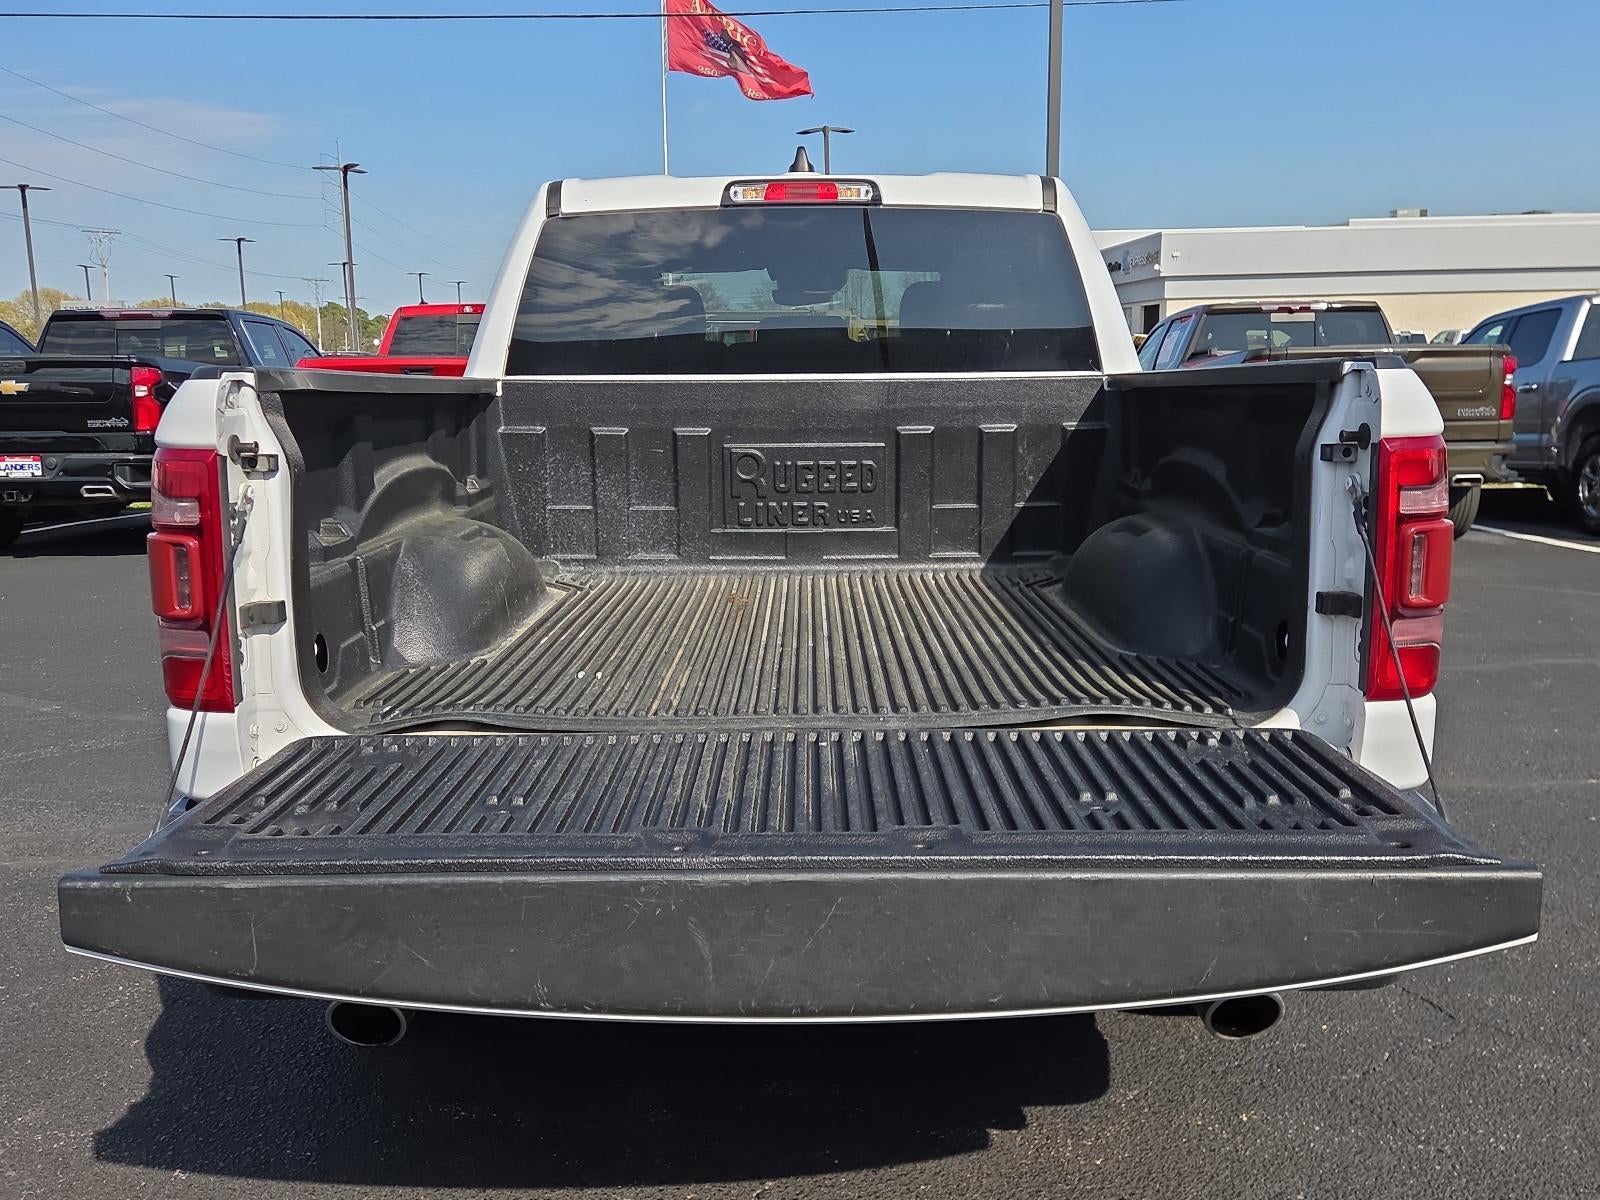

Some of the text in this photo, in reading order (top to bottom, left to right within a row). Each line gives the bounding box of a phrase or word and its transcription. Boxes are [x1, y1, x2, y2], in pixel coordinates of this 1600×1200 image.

[730, 448, 877, 499] RUGGED
[737, 501, 876, 526] LINER USA
